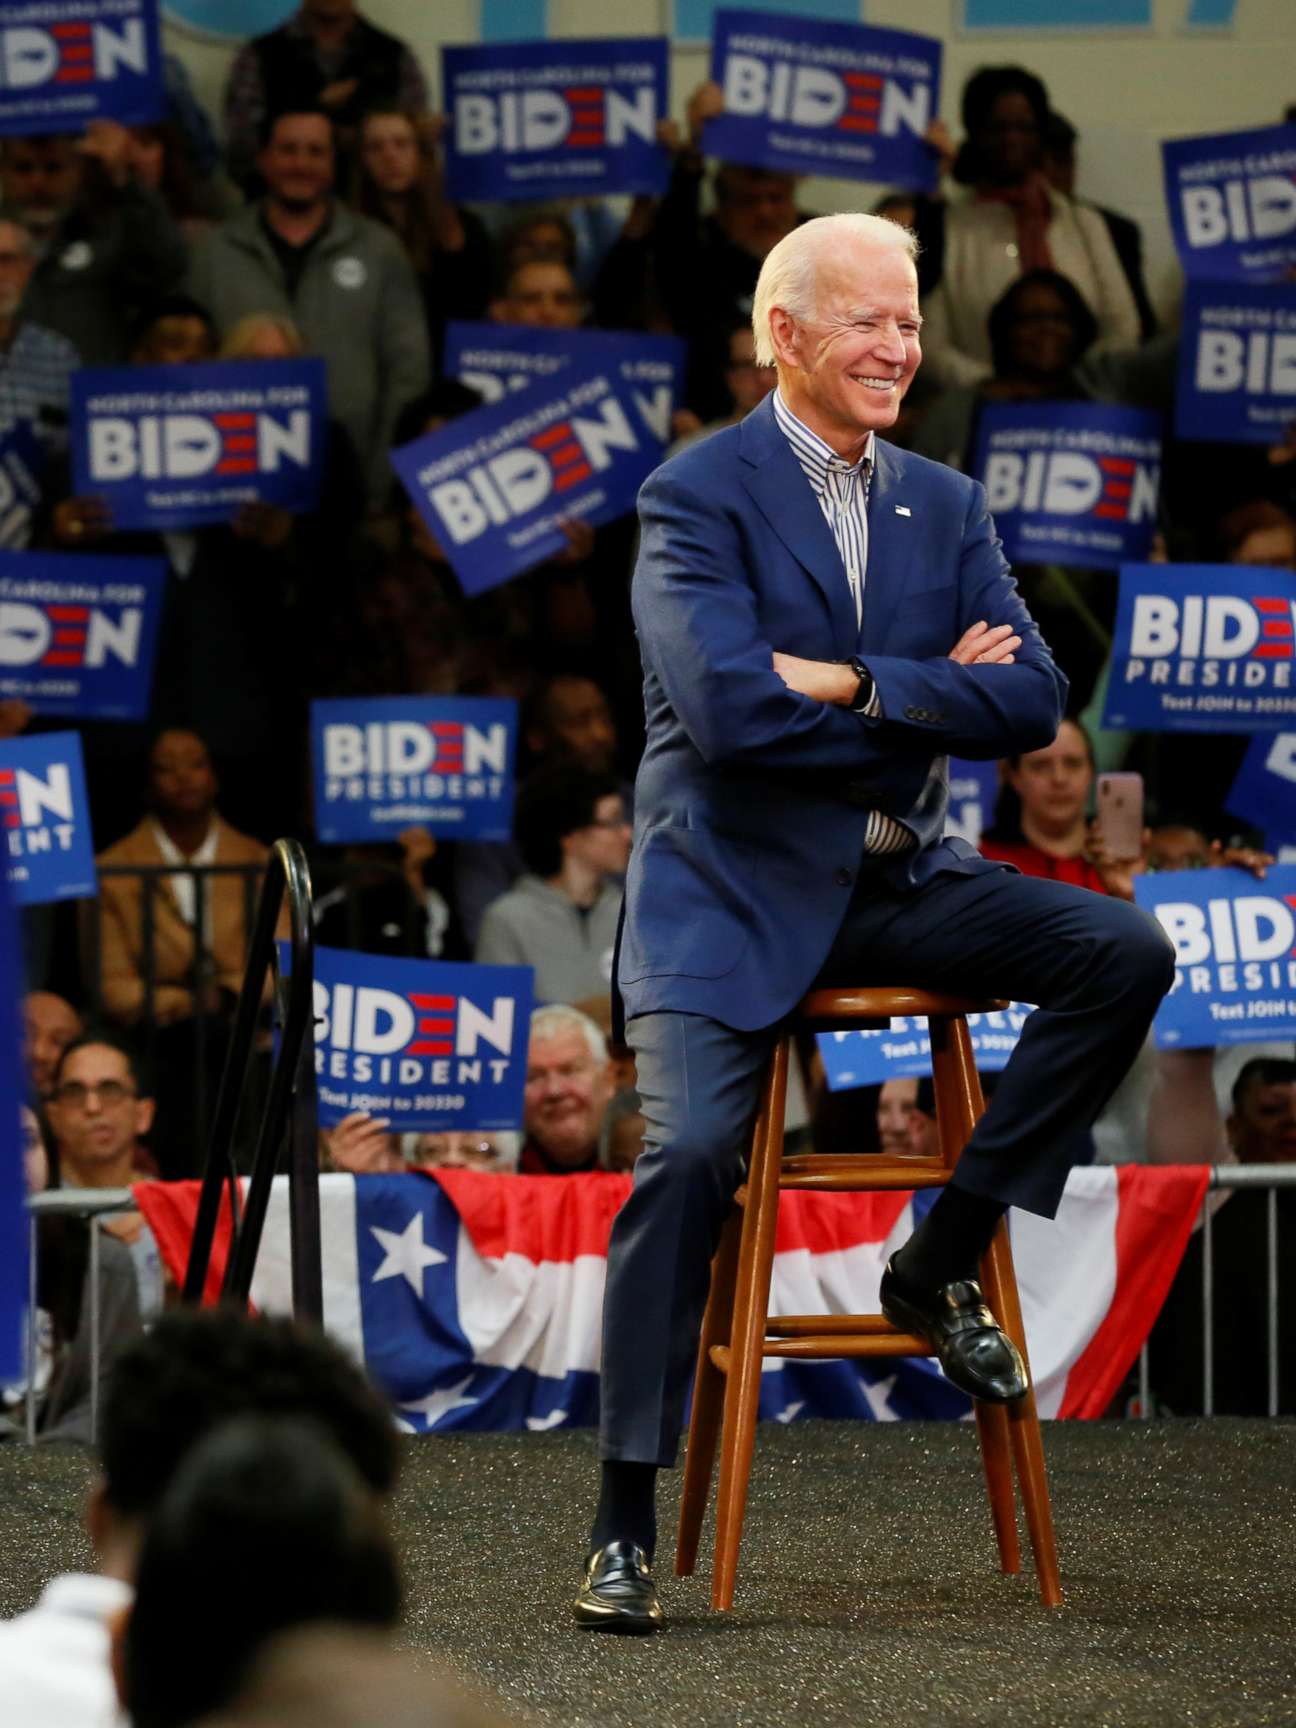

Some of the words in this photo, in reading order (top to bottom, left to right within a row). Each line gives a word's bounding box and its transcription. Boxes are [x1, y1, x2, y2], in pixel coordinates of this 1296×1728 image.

[454, 86, 656, 156] BIDEN
[723, 53, 931, 137] BIDEN
[1181, 175, 1296, 249] BID
[88, 409, 311, 481] BIDEN
[429, 395, 639, 545] BIDEN
[985, 450, 1160, 525] BIDEN
[1130, 594, 1296, 660] BIDE
[1125, 659, 1292, 688] PRESIDE
[324, 721, 507, 777] BIDEN
[324, 774, 503, 800] PRESIDENT
[1155, 895, 1296, 966] BID
[1168, 962, 1296, 996] PRESI
[1209, 1001, 1245, 1021] Text
[1247, 998, 1286, 1019] JOIN
[314, 1047, 510, 1086] RESIDENT
